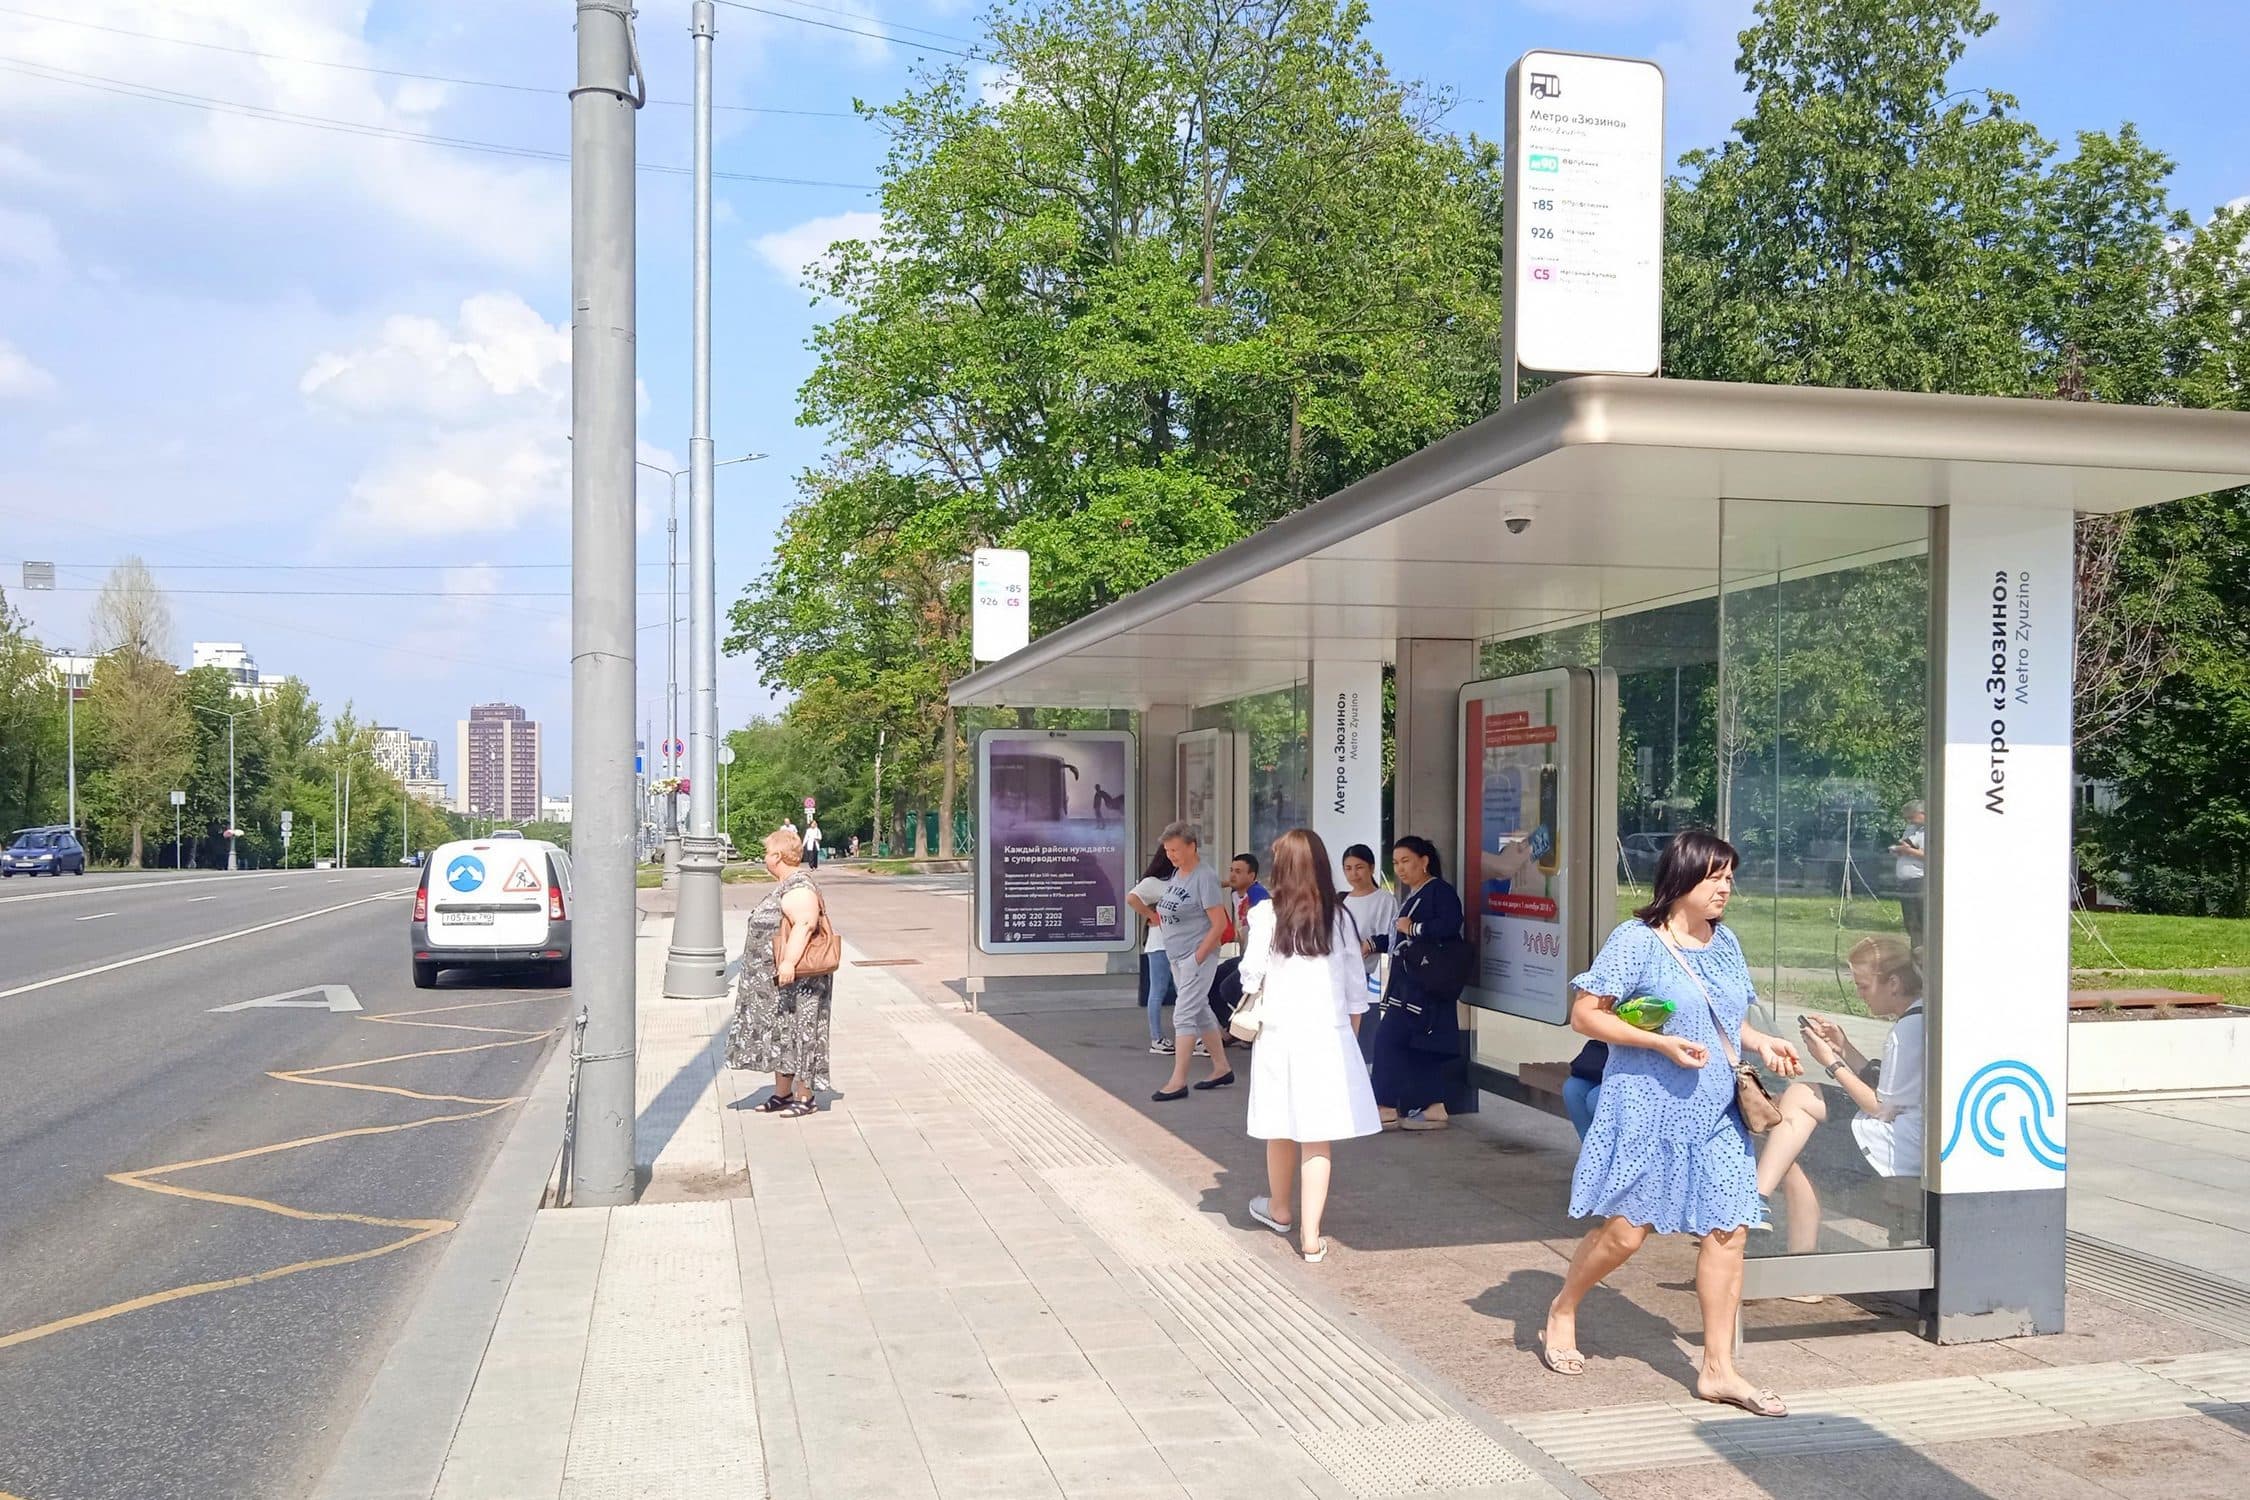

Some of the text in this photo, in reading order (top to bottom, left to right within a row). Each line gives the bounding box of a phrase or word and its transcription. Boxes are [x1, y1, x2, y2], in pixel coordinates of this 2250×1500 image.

[1530, 109, 1627, 129] Метро «Зюзино»
[1531, 227, 1554, 239] 926
[1533, 268, 1550, 280] С5
[980, 597, 998, 606] 926
[2015, 571, 2032, 704] Metro Zyuzino
[1985, 570, 2009, 814] Метро «Зюзино»
[1350, 693, 1360, 760] Metro Zyuzino
[1334, 693, 1348, 814] Метро «Зюзино»
[1004, 845, 1115, 855] Каждый район нуждается
[1011, 855, 1080, 865] суперводителе.
[1028, 920, 1042, 928] 622
[1045, 920, 1063, 928] 2222
